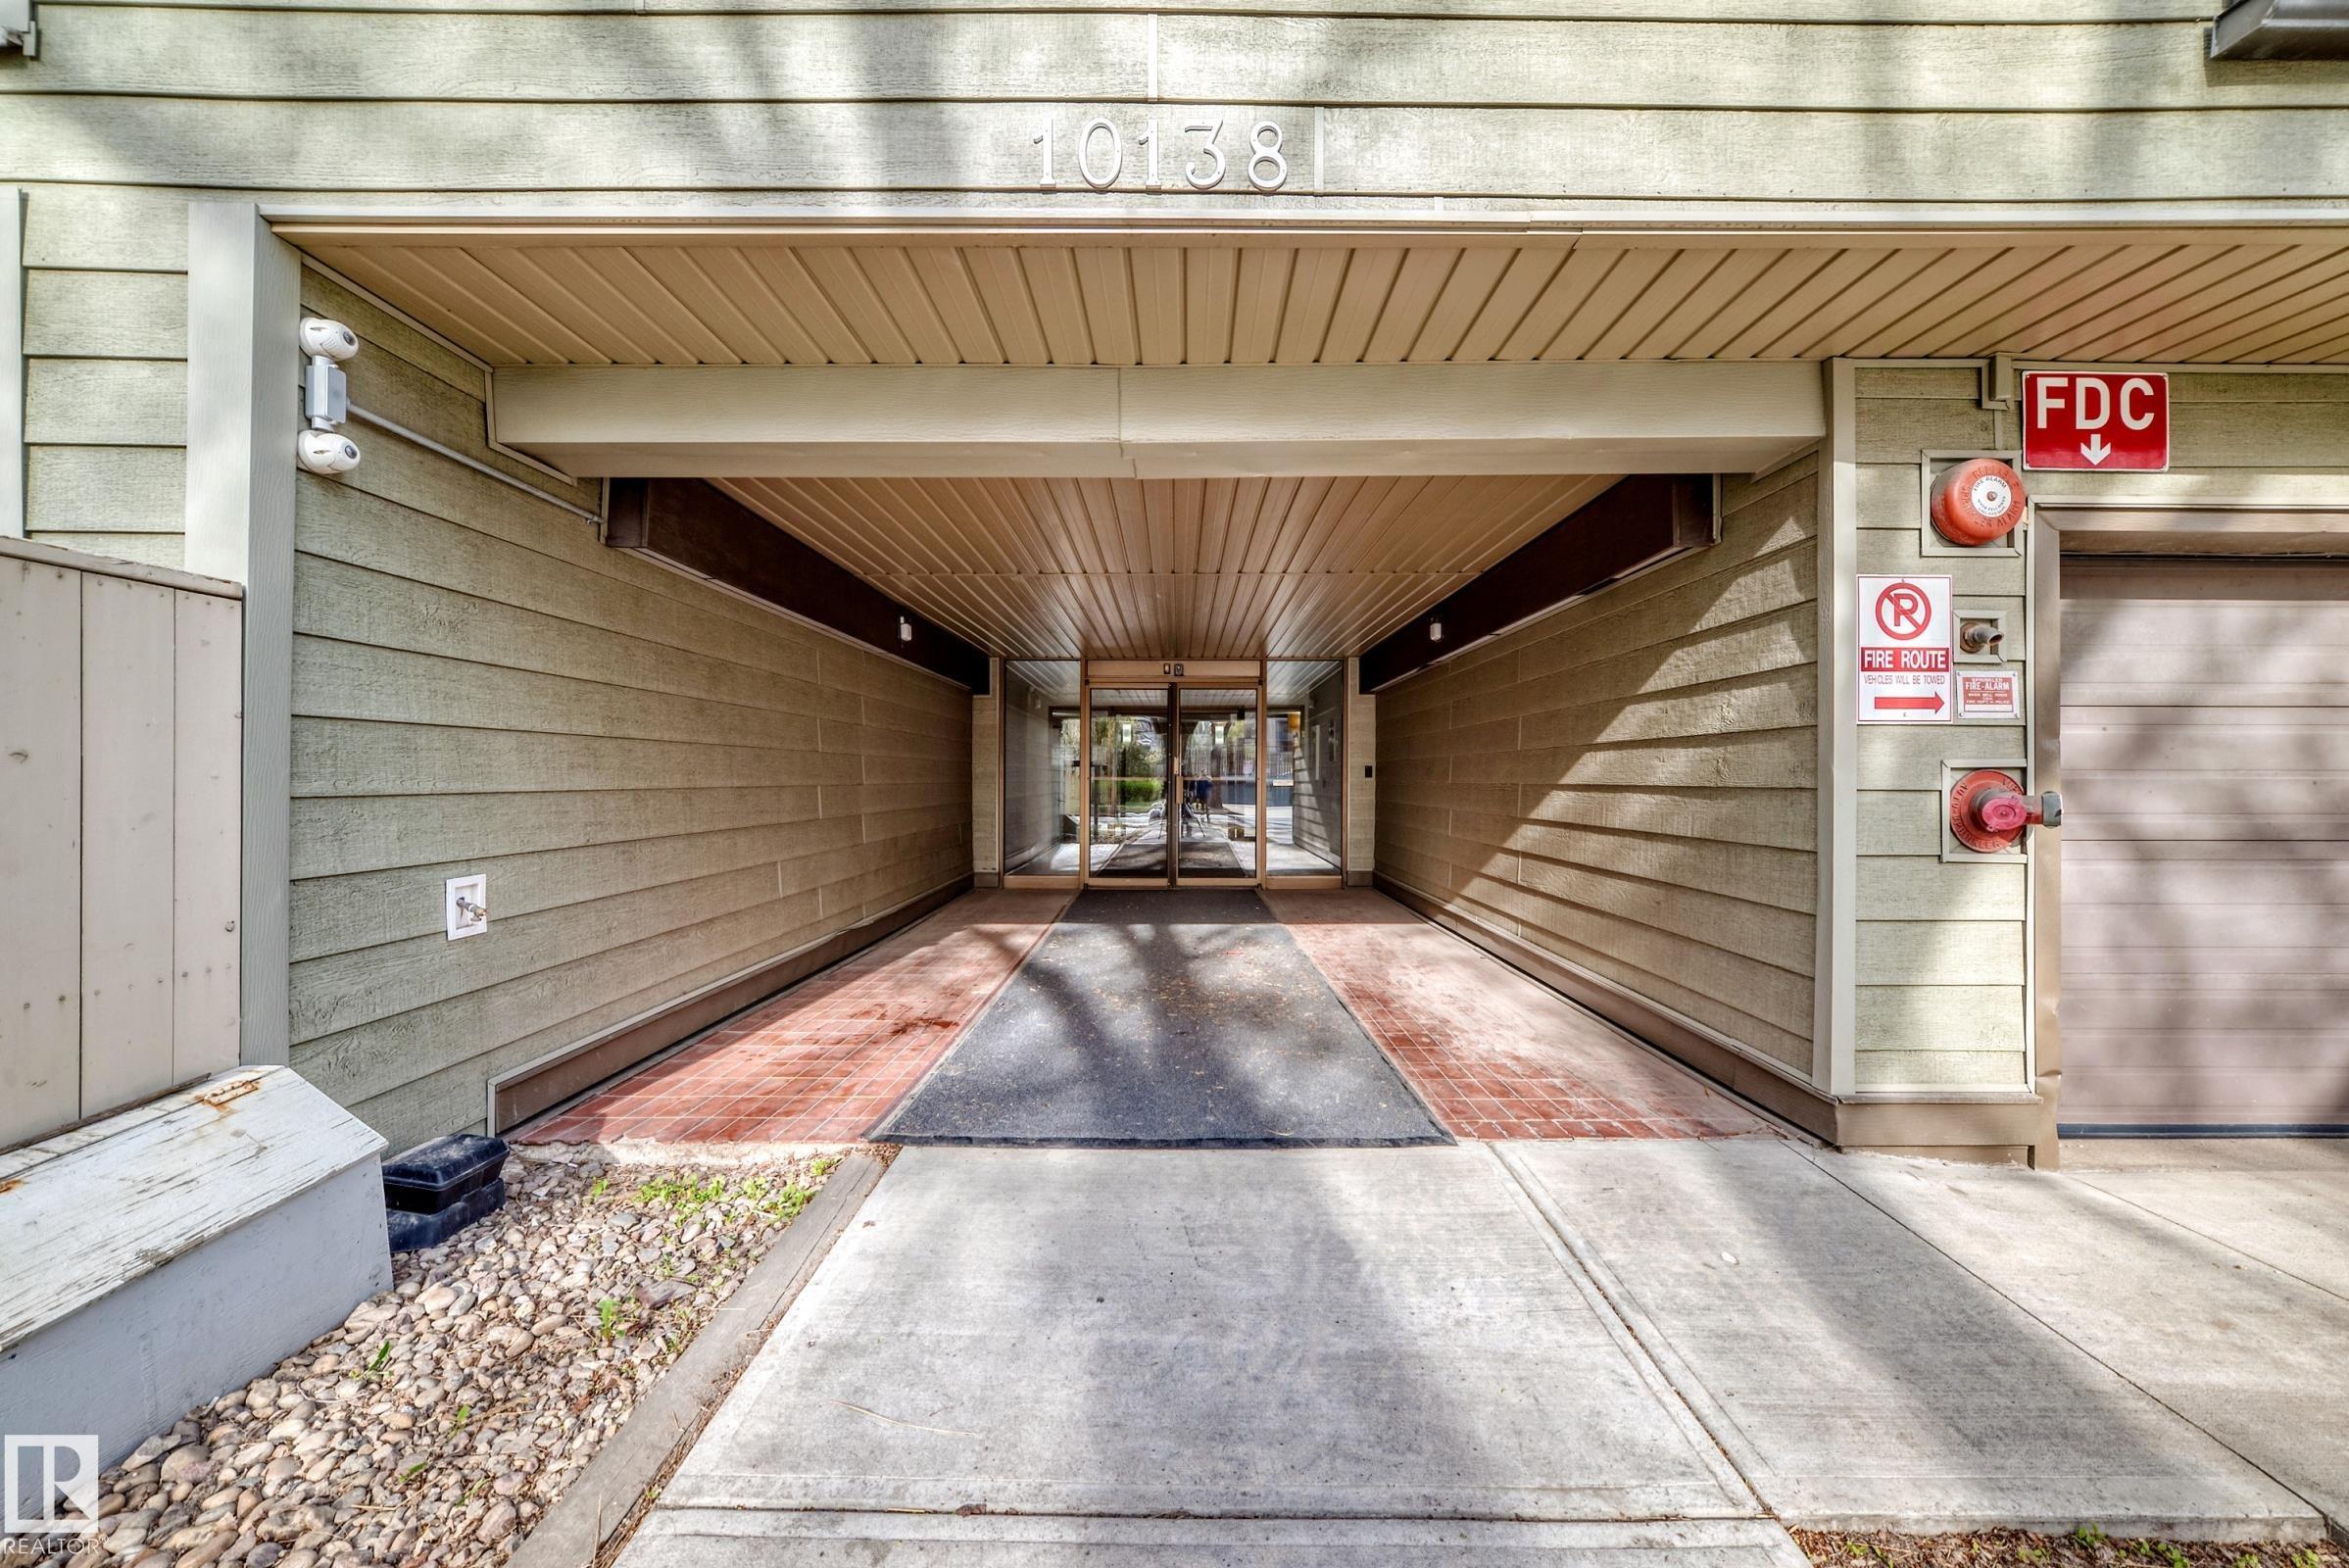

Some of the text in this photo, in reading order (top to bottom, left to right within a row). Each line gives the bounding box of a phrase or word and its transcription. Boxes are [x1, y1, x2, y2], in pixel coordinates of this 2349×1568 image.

[1033, 117, 1288, 190] 10138
[2036, 377, 2155, 430] FDC
[1864, 650, 1947, 668] FIRE ROUTE
[1895, 674, 1910, 685] WILL
[1912, 674, 1921, 685] BE
[1924, 674, 1945, 685] TOWED
